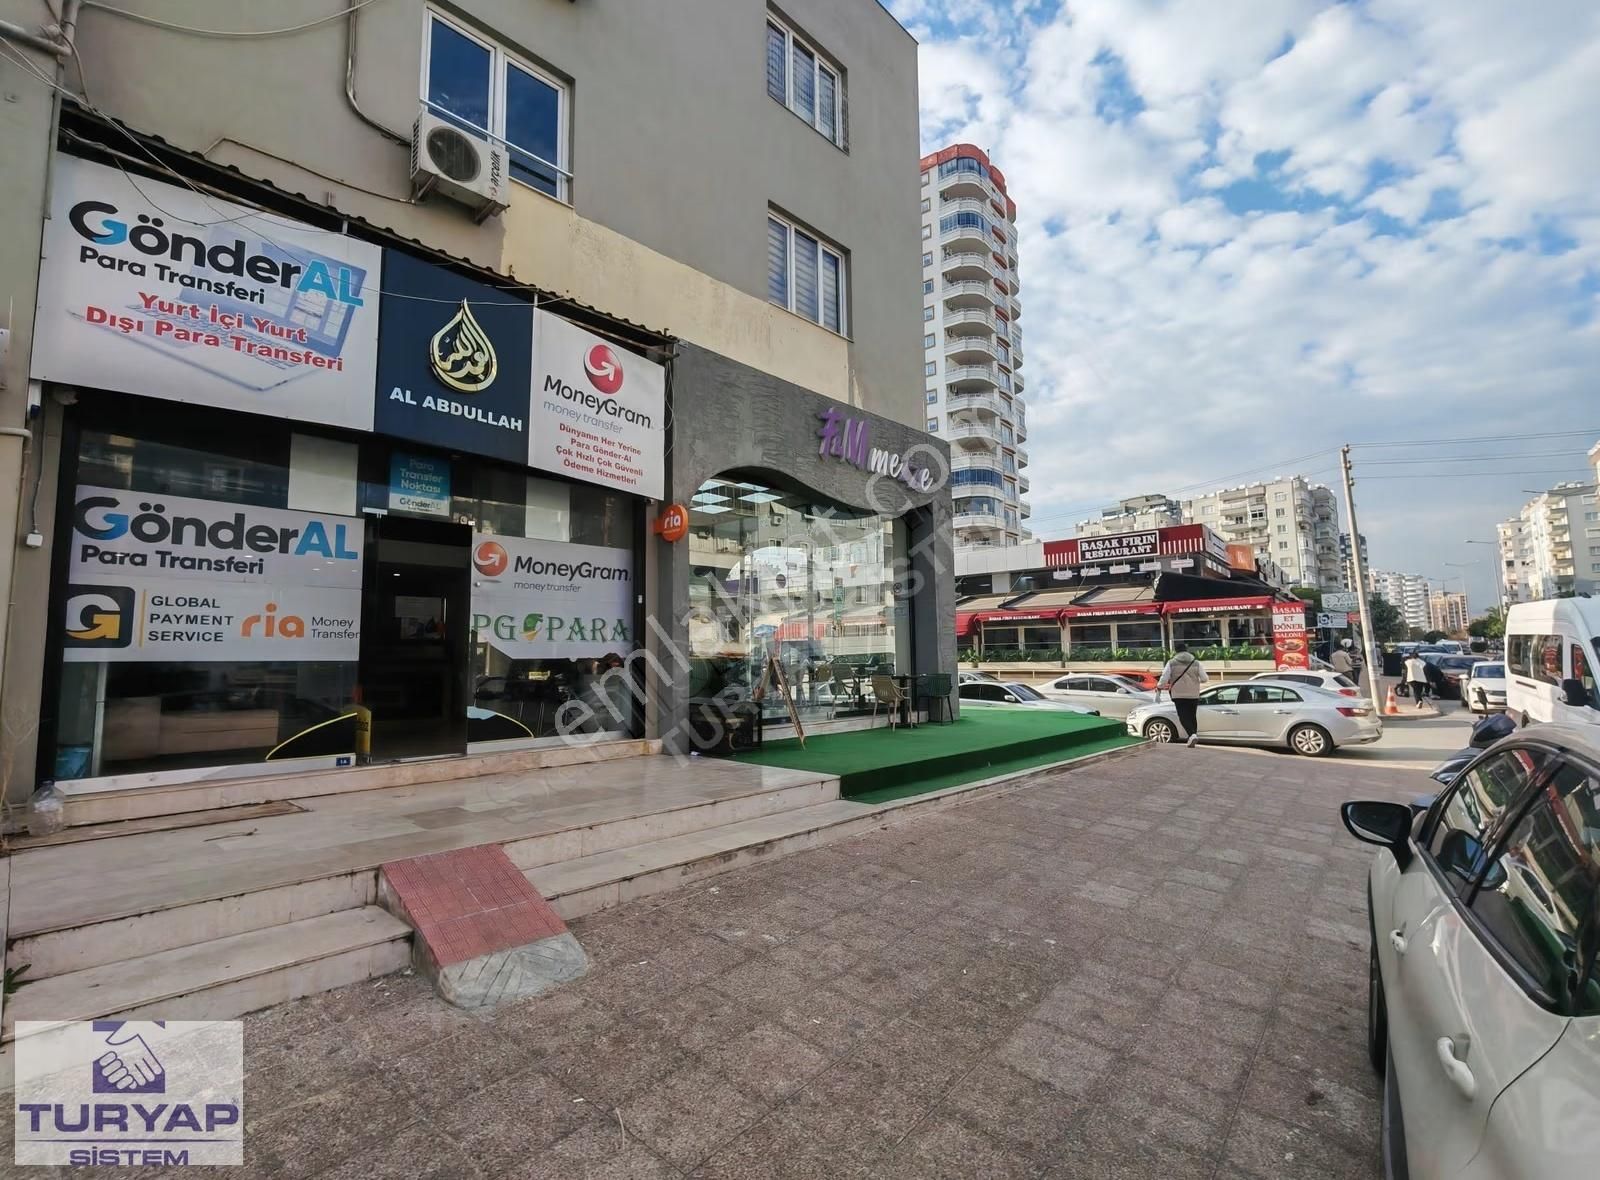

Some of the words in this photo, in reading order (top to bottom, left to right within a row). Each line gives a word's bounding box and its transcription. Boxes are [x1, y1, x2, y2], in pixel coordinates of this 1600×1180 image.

[69, 200, 364, 307] GönderAL
[80, 245, 146, 277] Para
[154, 263, 265, 305] Transferi
[138, 292, 206, 324] Yurt
[210, 305, 243, 330] İçi
[253, 317, 308, 343] Yurt
[86, 305, 144, 334] Dışı
[155, 320, 220, 347] Para
[230, 335, 344, 372] Transferi
[389, 387, 417, 406] AL
[422, 395, 522, 432] ABDULLAH
[544, 401, 582, 422] money
[583, 413, 624, 435] transfer
[560, 422, 599, 442] Dünyanın
[601, 437, 616, 447] Her
[617, 441, 642, 456] Yerine
[570, 438, 590, 450] Para
[593, 445, 632, 463] Gönder-Al
[556, 445, 573, 457] Çok
[576, 451, 595, 463] Hızlı
[597, 455, 613, 468] Çok
[615, 461, 643, 477] Güvenli
[563, 458, 594, 474] Ödeme
[596, 465, 637, 485] Hizmetleri
[73, 496, 358, 560] GönderAL
[664, 511, 681, 529] ria
[80, 544, 147, 567] Para
[155, 550, 264, 575] Transferi
[1085, 545, 1152, 559] RESTAURANT
[151, 595, 220, 609] GLOBAL
[514, 582, 545, 592] money
[546, 583, 582, 593] transfer
[150, 613, 234, 626] PAYMENT
[240, 603, 305, 638] ria
[311, 616, 354, 630] Money
[546, 616, 631, 642] PARA
[148, 630, 224, 642] SERVICE
[311, 629, 360, 640] Transfer
